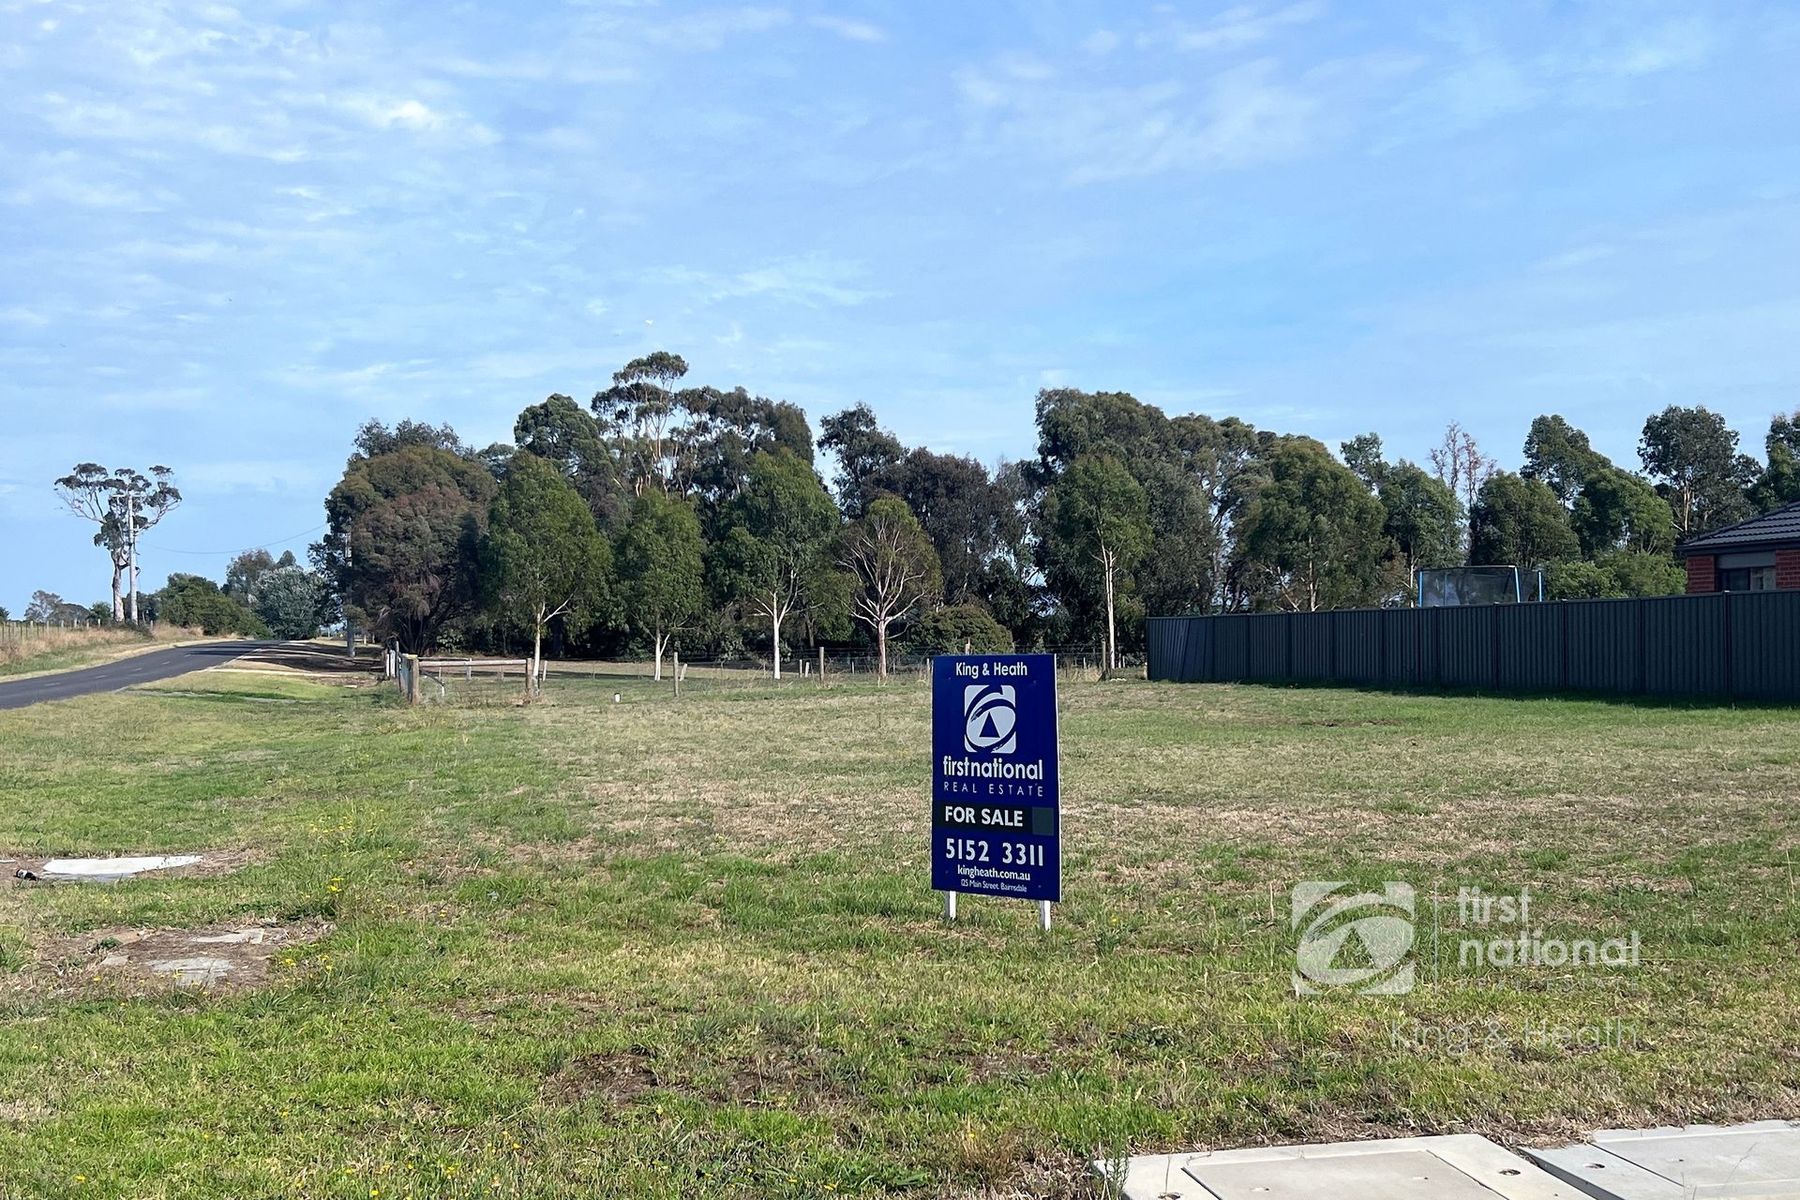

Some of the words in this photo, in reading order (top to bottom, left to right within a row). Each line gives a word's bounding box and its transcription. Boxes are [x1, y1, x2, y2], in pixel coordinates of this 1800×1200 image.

[956, 662, 979, 679] King
[982, 662, 990, 676] &
[993, 662, 1028, 676] Heath
[943, 781, 977, 793] REAL
[988, 783, 1043, 797] ESTATE
[945, 805, 976, 824] FOR
[981, 808, 1024, 827] SALE
[945, 837, 990, 862] 5152
[1002, 842, 1044, 867] 3311
[957, 864, 1031, 880] kingheath.com.au
[969, 879, 982, 888] Main
